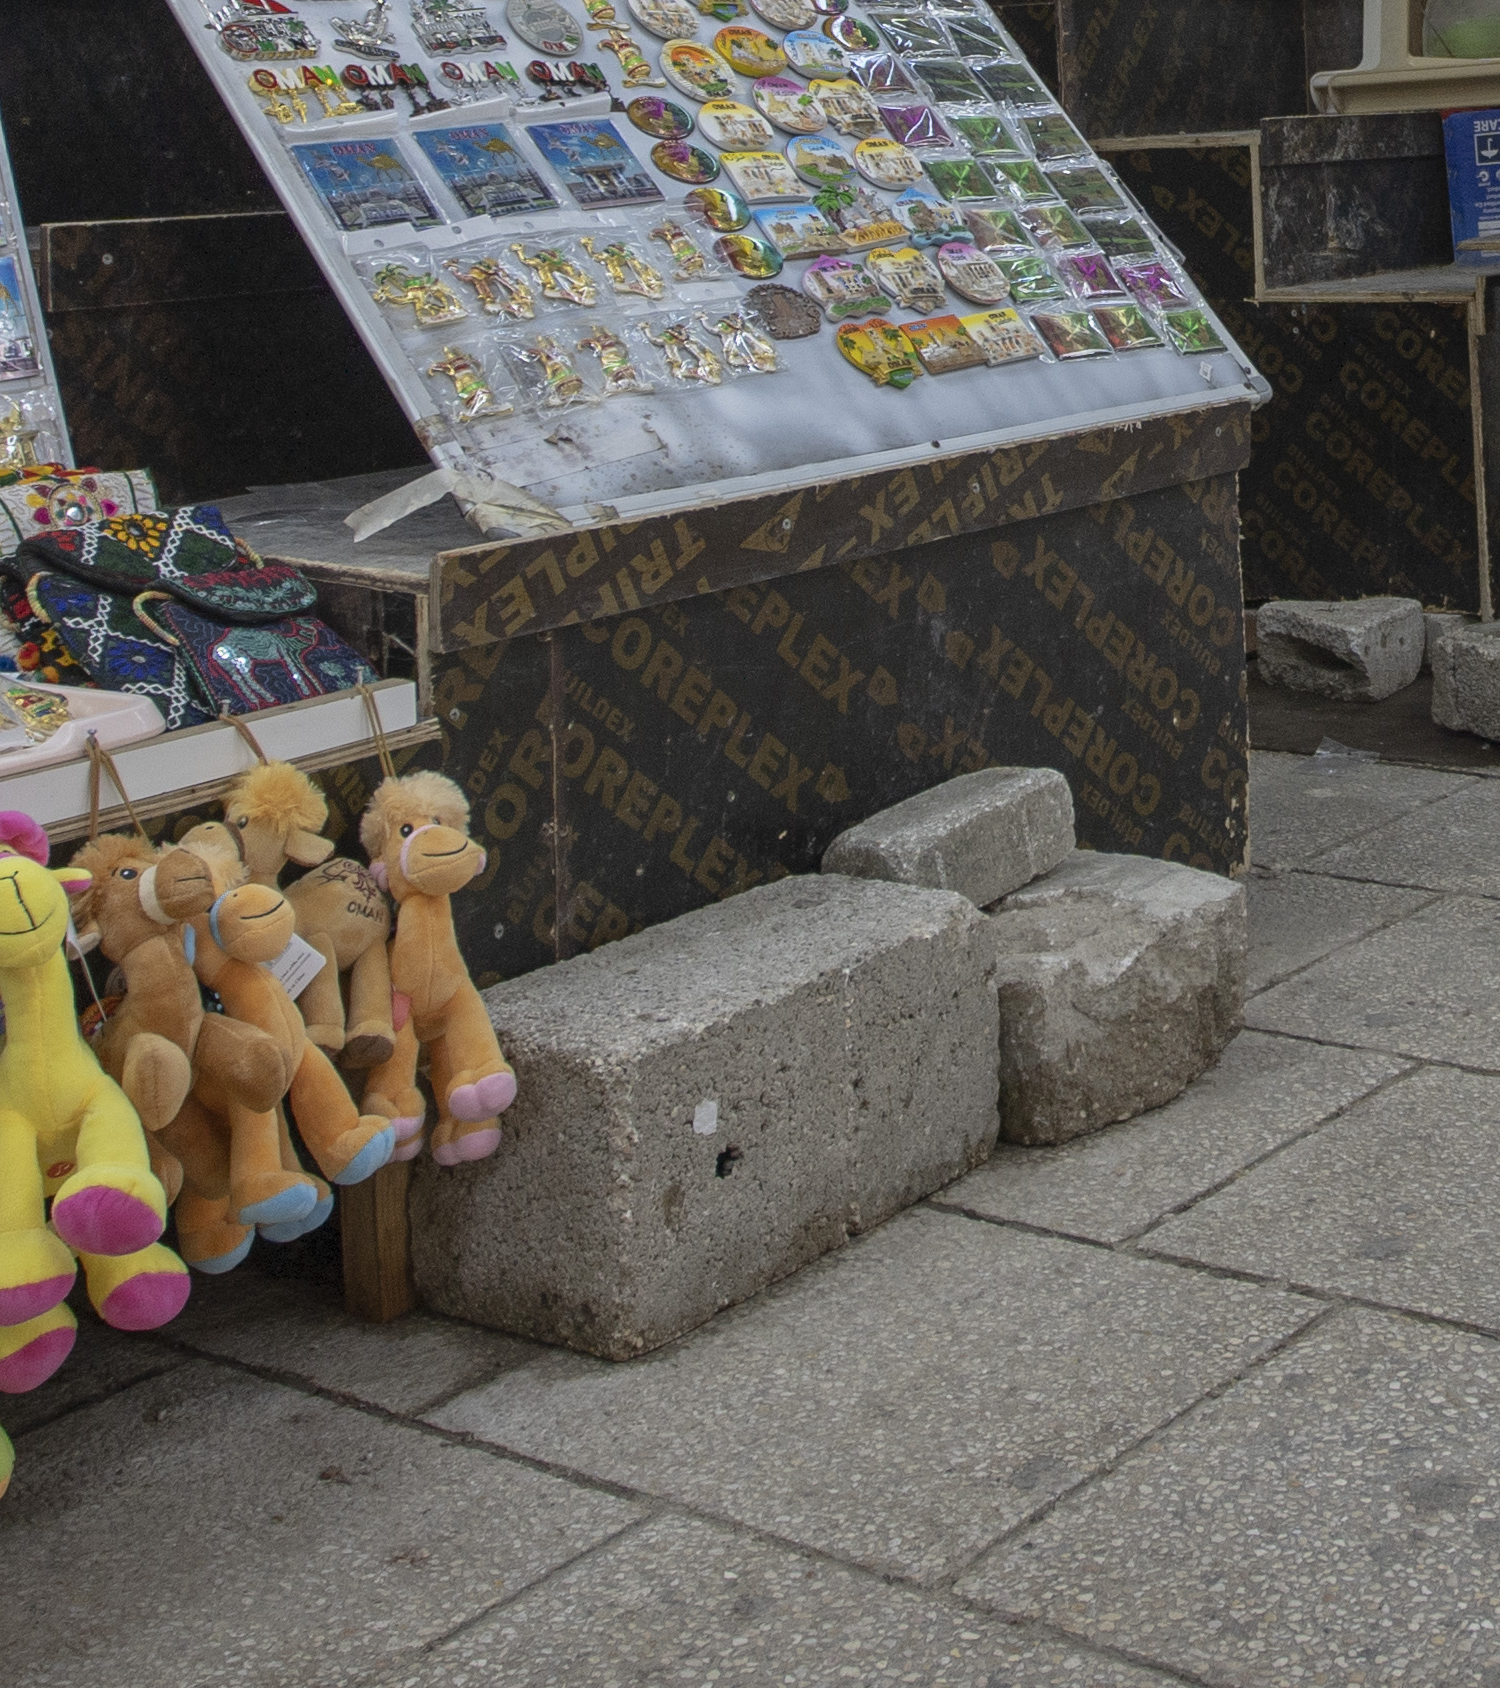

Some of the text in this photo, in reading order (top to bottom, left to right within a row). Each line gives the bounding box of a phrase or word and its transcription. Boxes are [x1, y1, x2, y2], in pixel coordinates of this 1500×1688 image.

[253, 65, 341, 89] OMAN
[342, 63, 430, 86] OMAN
[441, 60, 521, 82] OMAN
[525, 60, 608, 83] OMAN
[450, 127, 490, 141] OMAN
[560, 122, 598, 136] OMAN
[332, 143, 376, 156] OMAN
